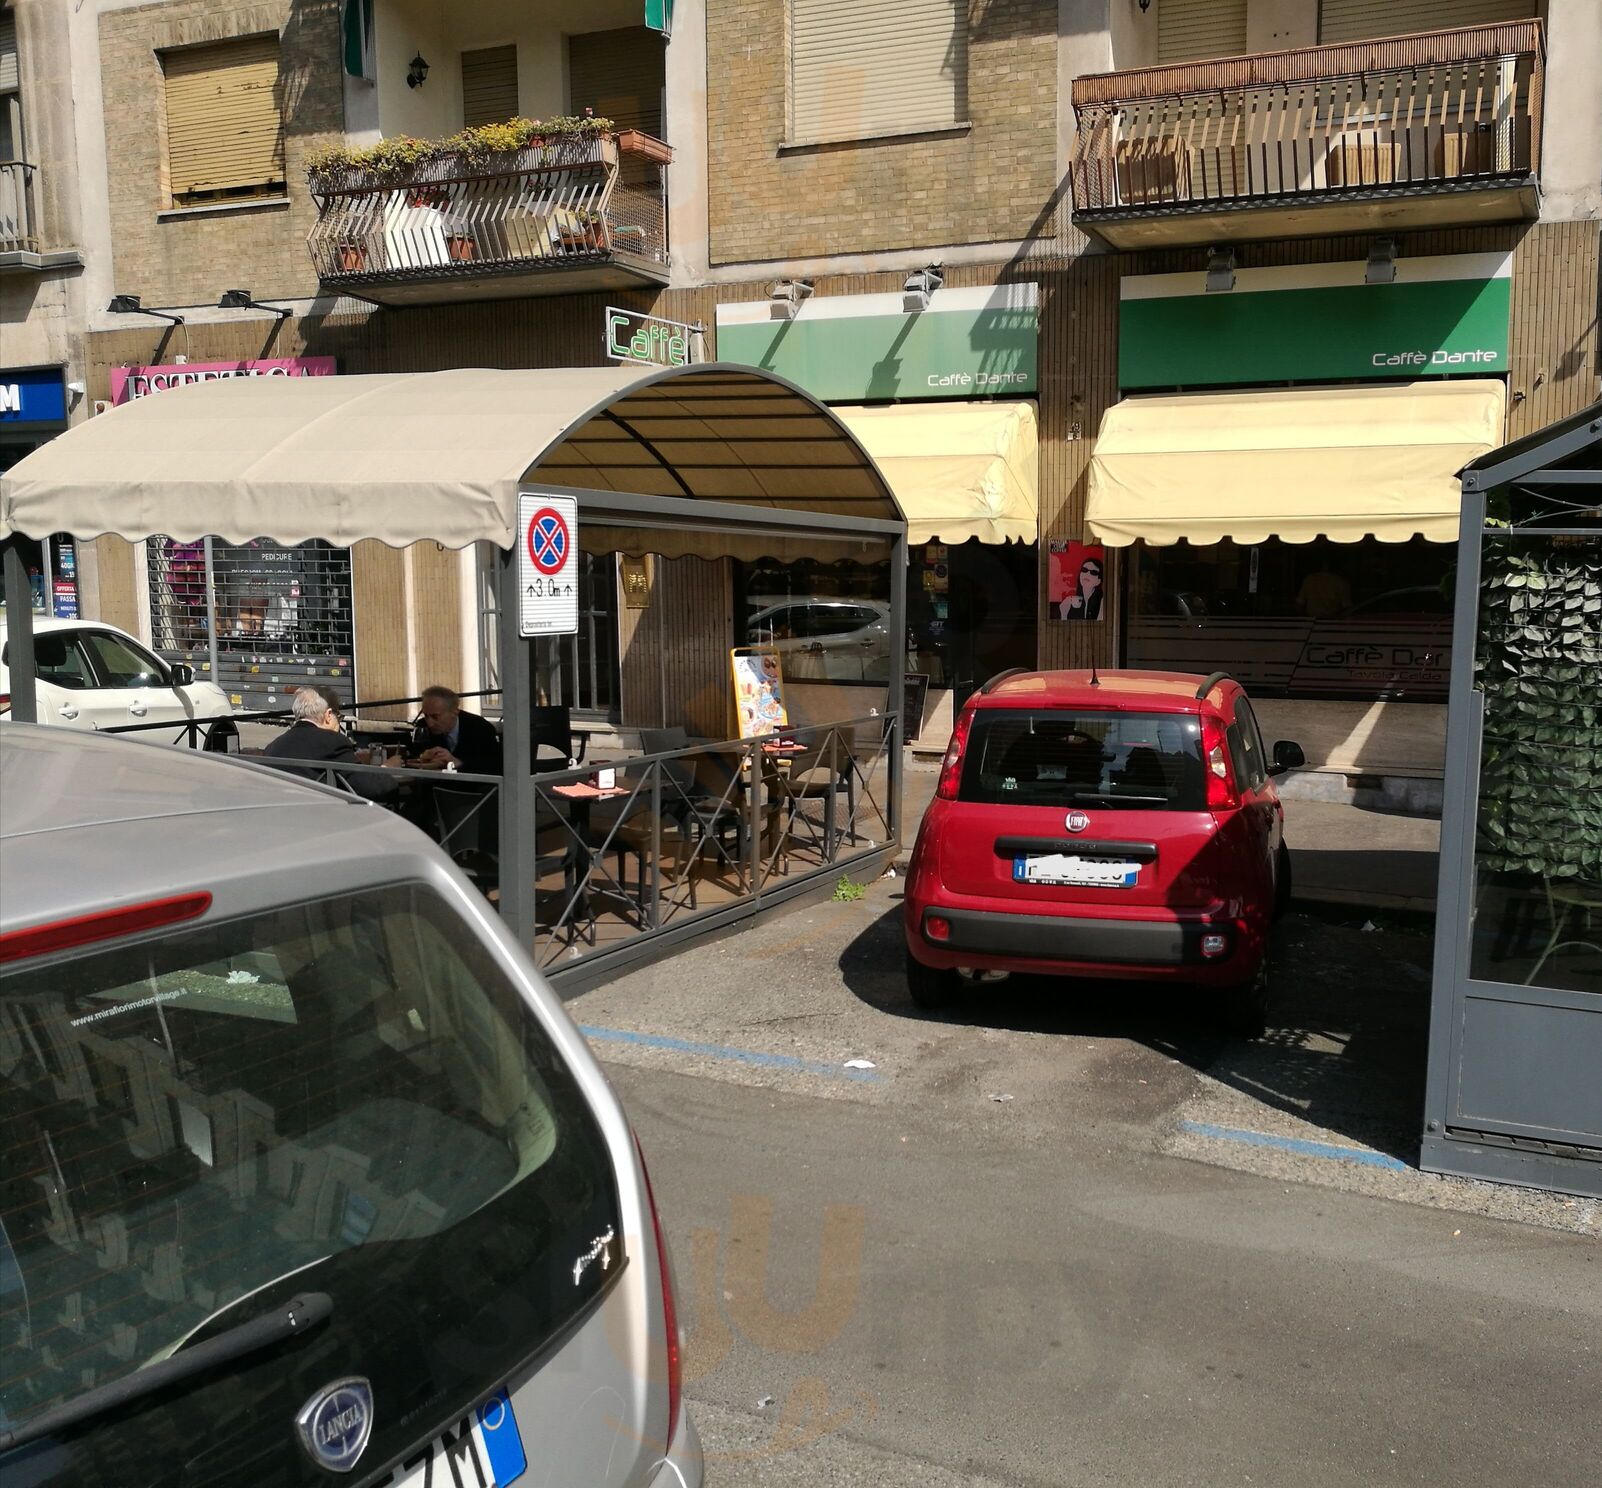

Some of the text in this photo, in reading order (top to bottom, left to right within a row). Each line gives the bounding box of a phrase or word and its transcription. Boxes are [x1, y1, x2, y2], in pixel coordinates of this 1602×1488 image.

[610, 315, 686, 366] Caffè
[1372, 349, 1498, 366] Caffè Dante
[927, 371, 1028, 387] Caffè Dante
[1306, 645, 1384, 665] Caffè
[1399, 670, 1442, 681] Calda
[1070, 815, 1084, 827] FIAT
[70, 988, 188, 1027] www.mirafiorimotorvillage.it
[318, 1404, 364, 1445] LANCIA
